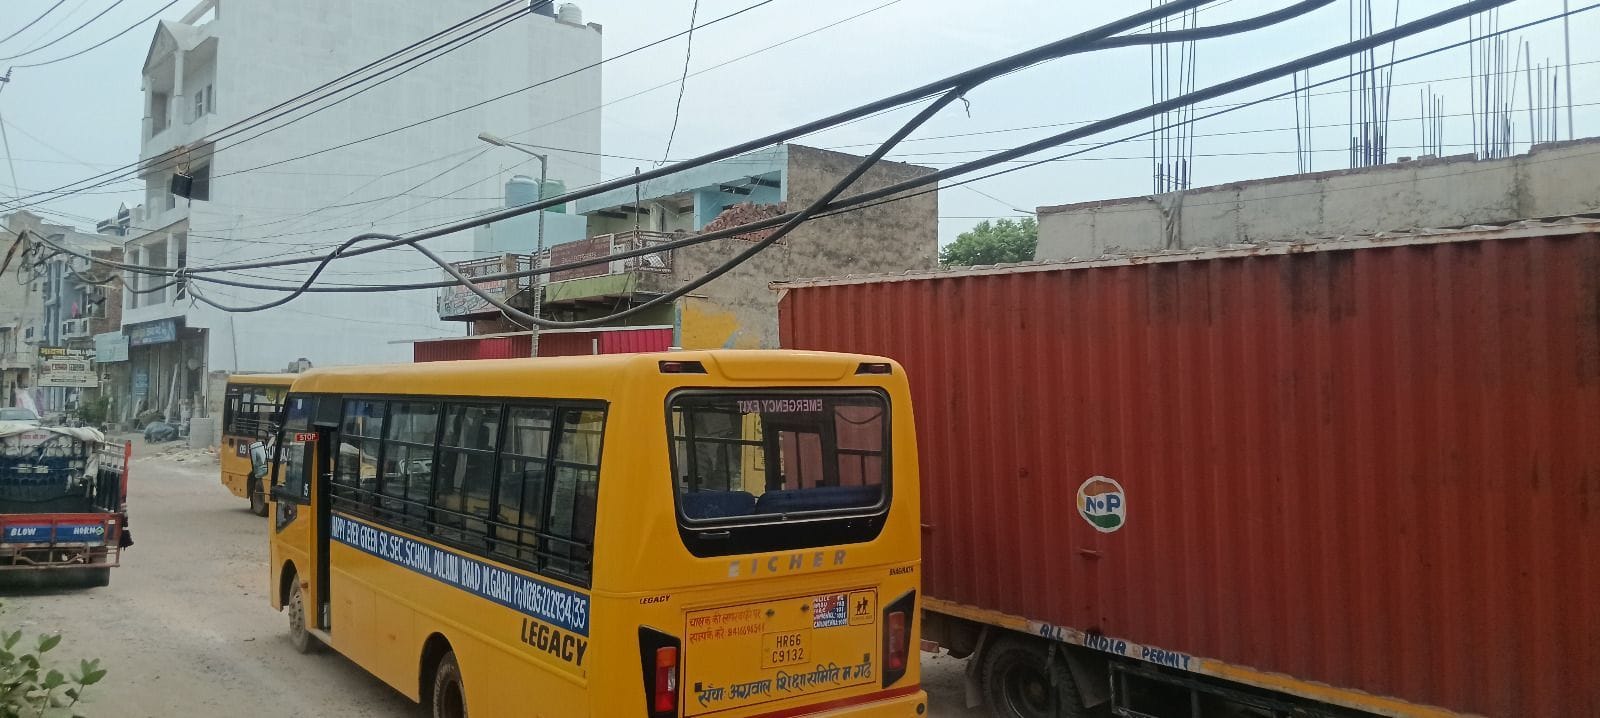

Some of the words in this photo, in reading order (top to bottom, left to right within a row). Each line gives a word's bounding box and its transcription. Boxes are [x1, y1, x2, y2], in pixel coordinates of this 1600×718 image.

[10, 527, 37, 537] BLOW
[346, 520, 360, 545] EVER
[360, 526, 378, 553] GREEN
[434, 549, 459, 583] DULANA
[461, 559, 481, 591] ROAD
[726, 549, 847, 577] EICHER
[639, 594, 671, 605] LEGACY
[520, 618, 588, 666] LEGACY
[776, 633, 802, 648] HR66
[1039, 624, 1063, 642] ALL
[1083, 632, 1127, 655] INDIA
[1141, 645, 1191, 670] PERMIT
[772, 649, 804, 664] C9132
